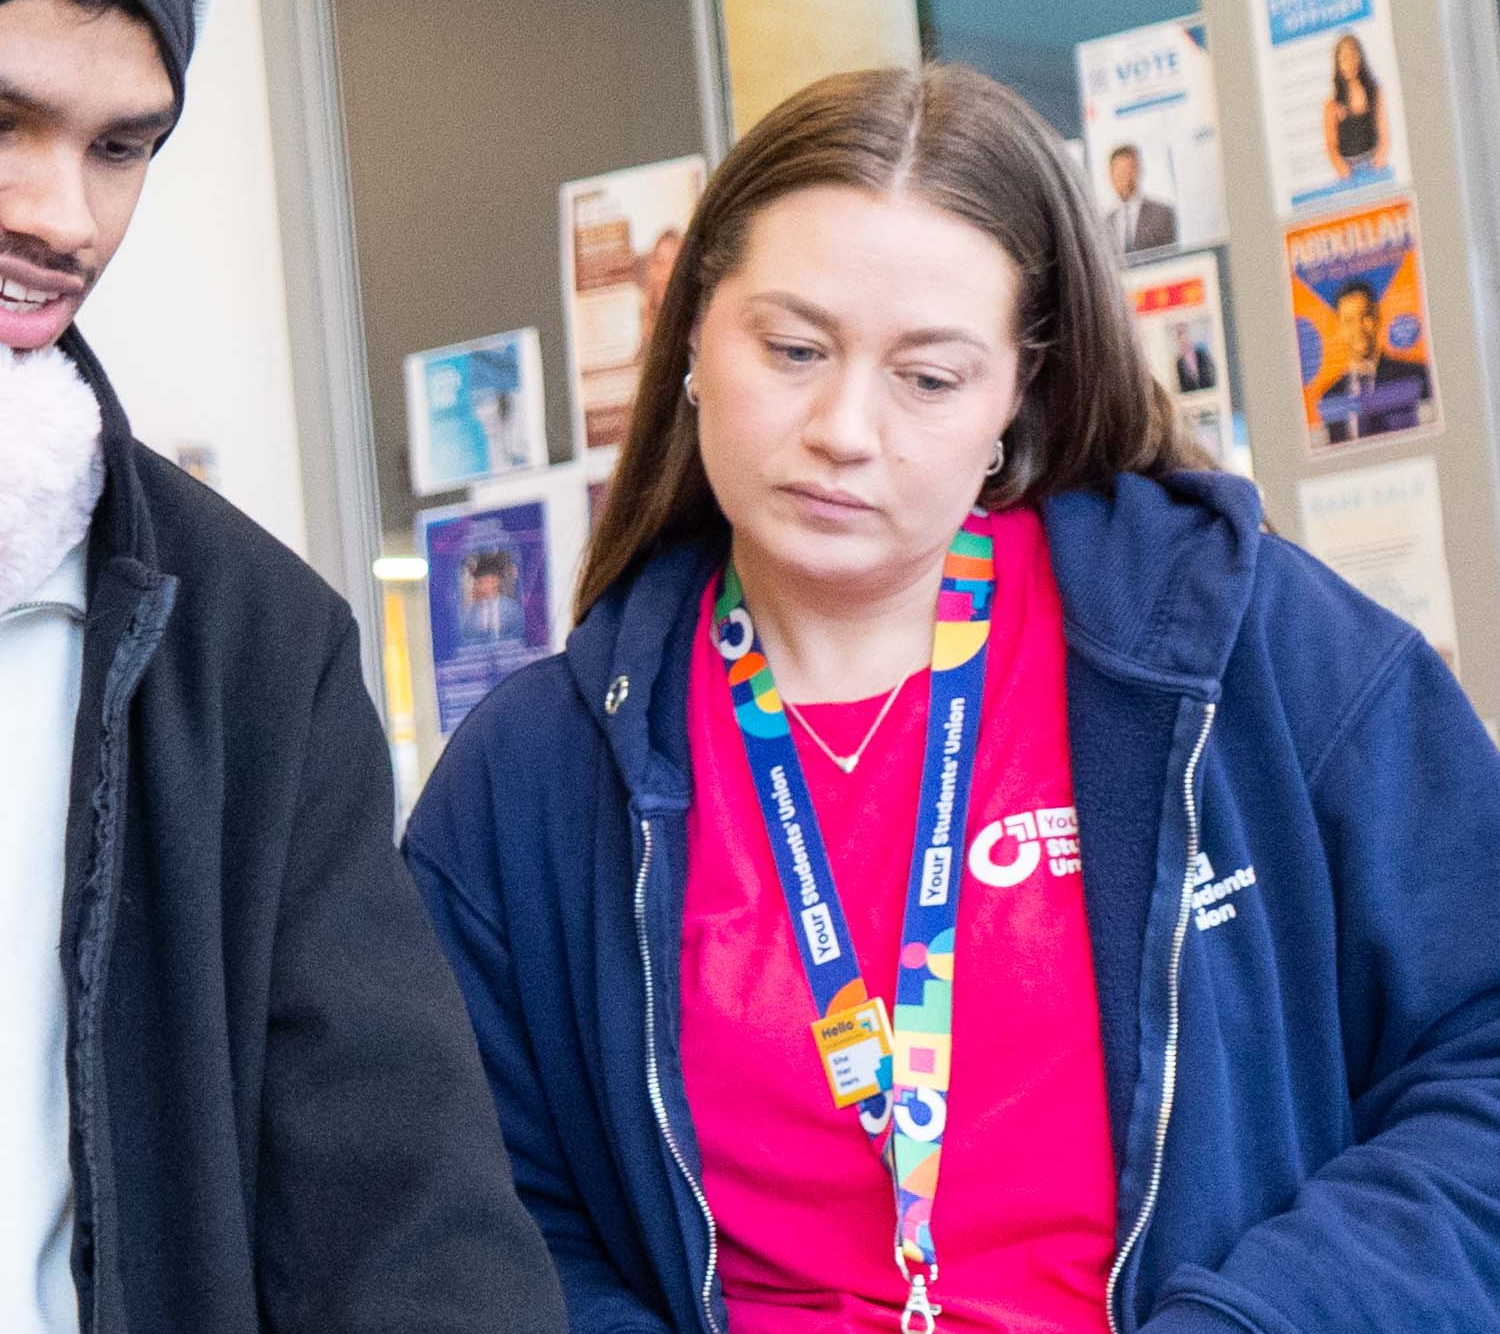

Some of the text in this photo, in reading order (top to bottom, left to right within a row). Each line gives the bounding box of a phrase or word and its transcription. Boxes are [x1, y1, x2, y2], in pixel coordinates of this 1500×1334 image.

[770, 765, 833, 957] Your Students' Union
[927, 697, 966, 900] Your Students' Union
[821, 1020, 854, 1040] Hello
